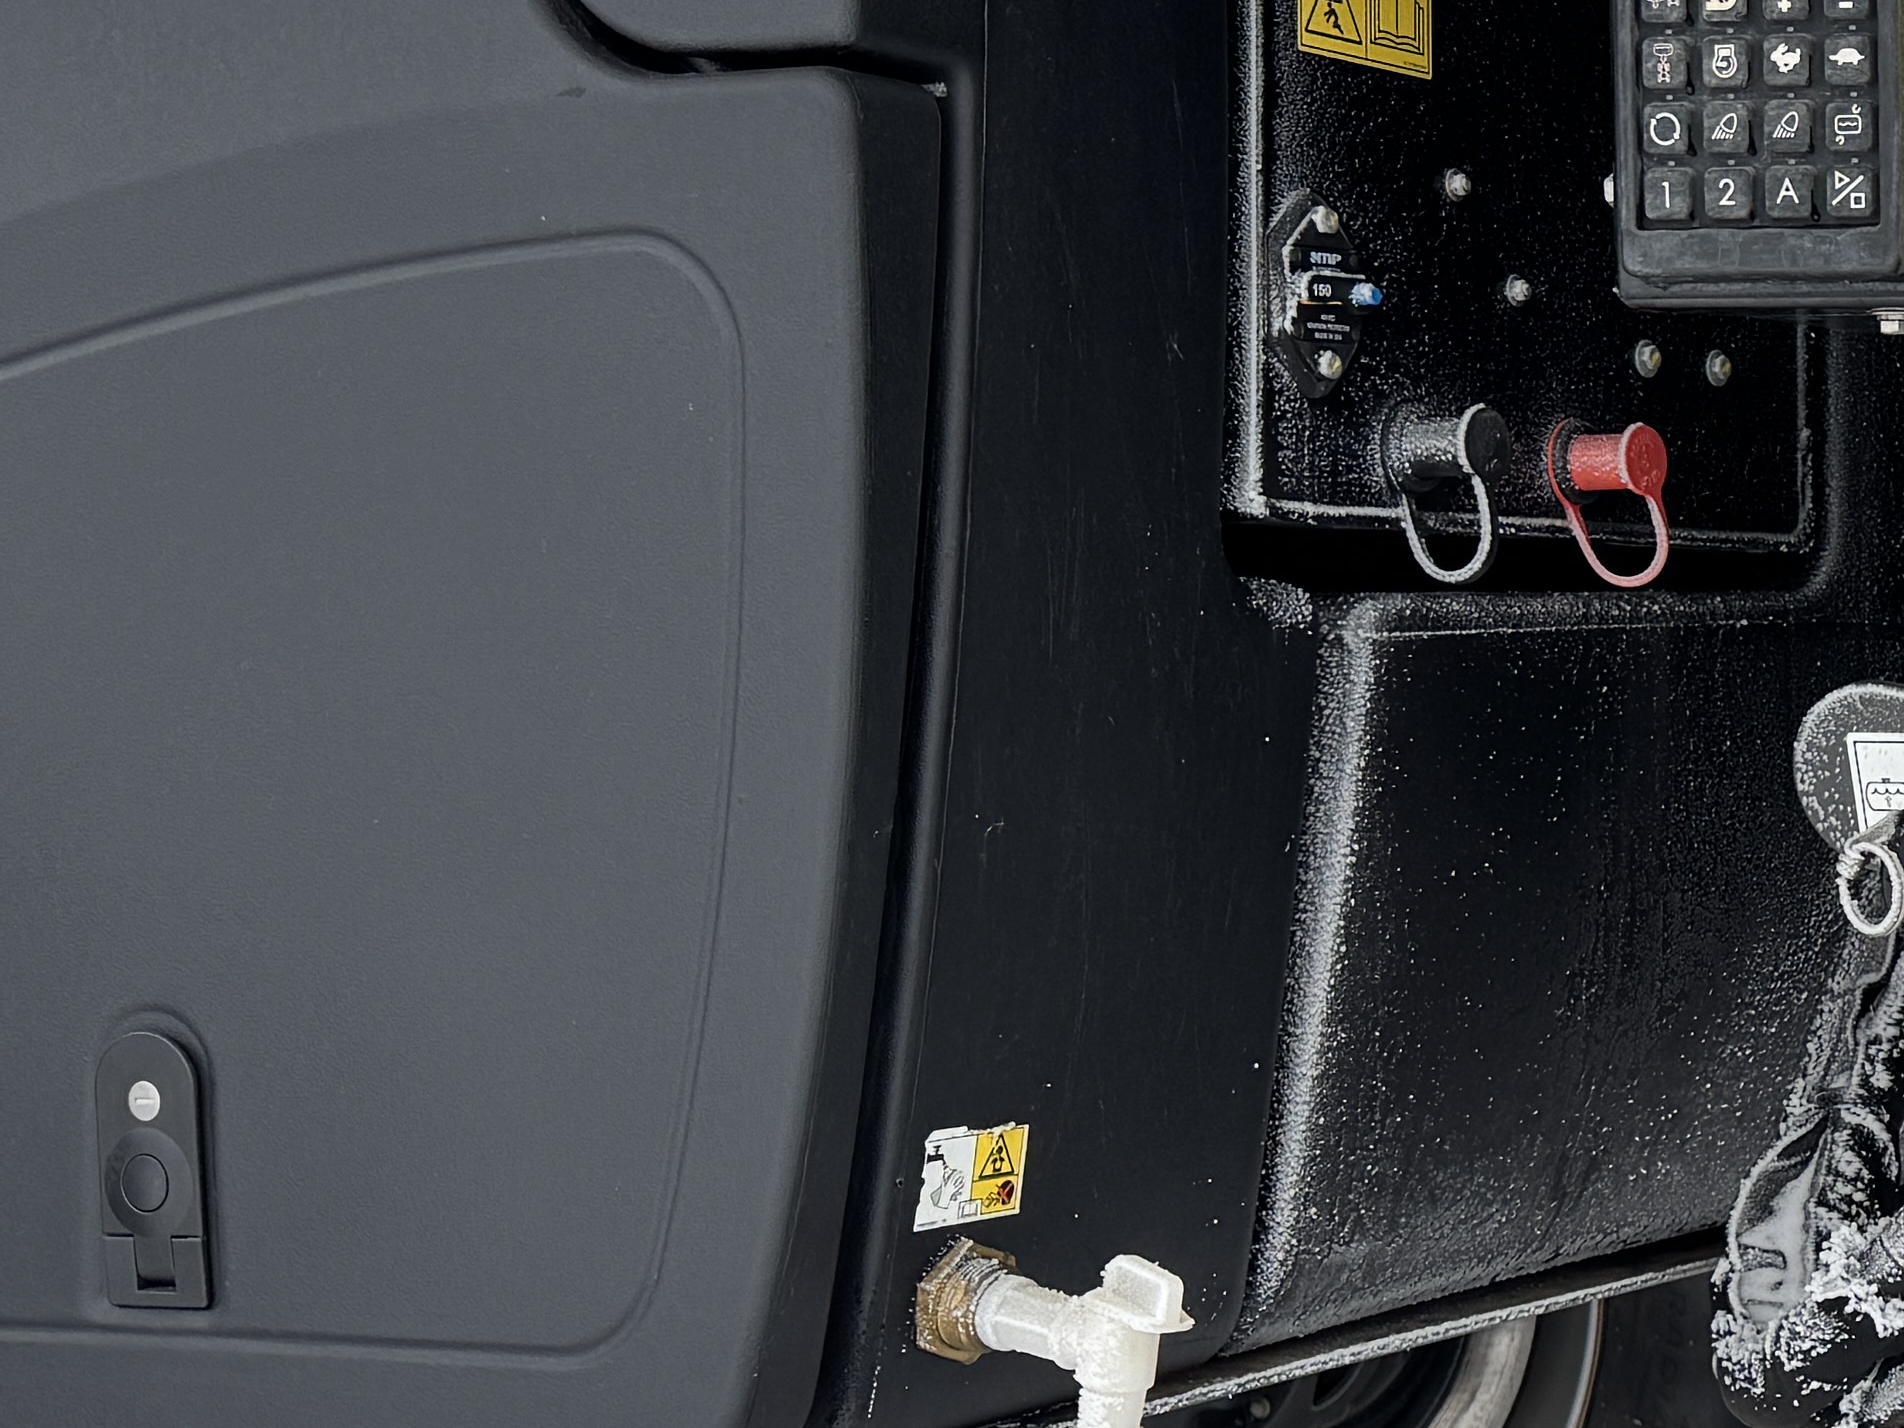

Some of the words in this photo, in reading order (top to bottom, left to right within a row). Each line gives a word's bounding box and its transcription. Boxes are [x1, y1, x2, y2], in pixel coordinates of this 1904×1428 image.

[1661, 181, 1671, 209] 1
[1718, 178, 1736, 206] 2
[1776, 177, 1800, 204] A
[1312, 283, 1332, 298] 150
